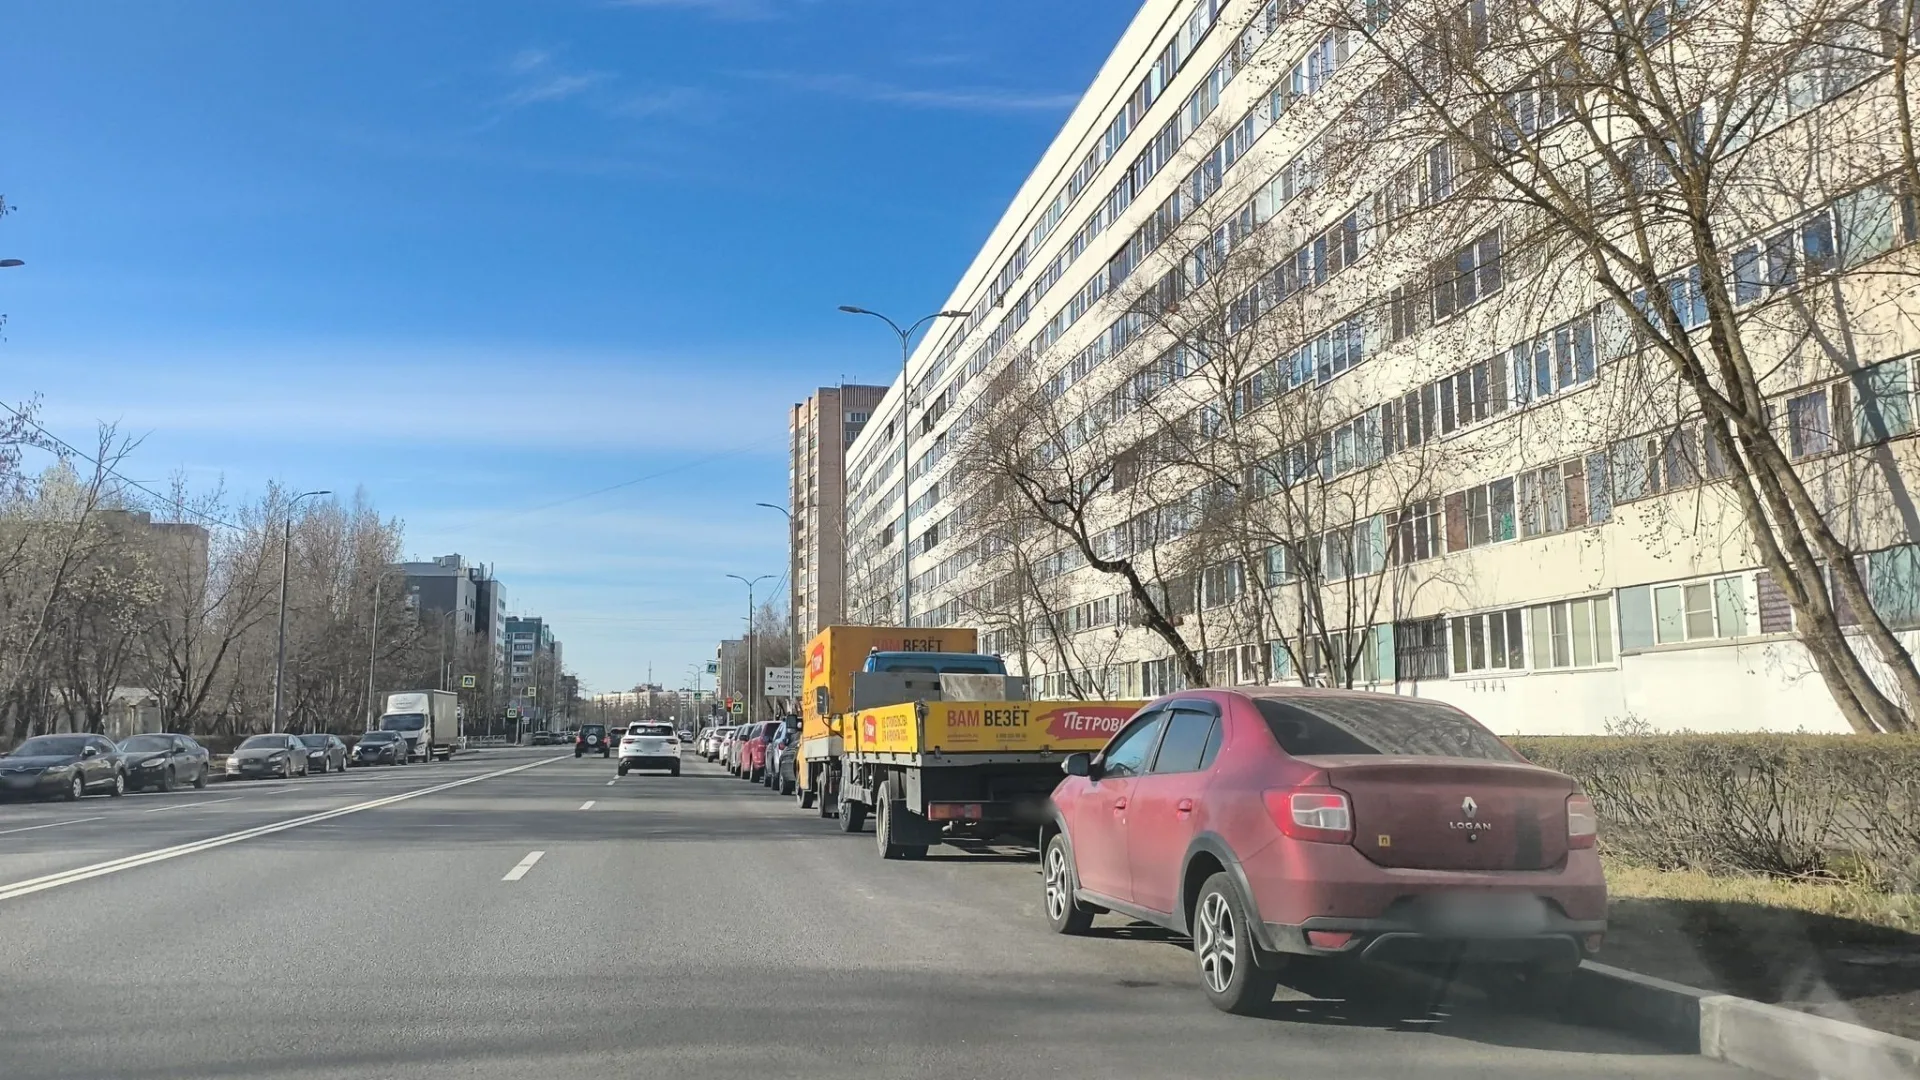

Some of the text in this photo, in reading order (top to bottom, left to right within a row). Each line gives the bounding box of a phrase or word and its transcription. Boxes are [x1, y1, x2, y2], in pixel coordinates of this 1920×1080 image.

[947, 705, 1029, 727] ВАМ ВЕЗЁТ
[1449, 821, 1492, 830] LOGAN
